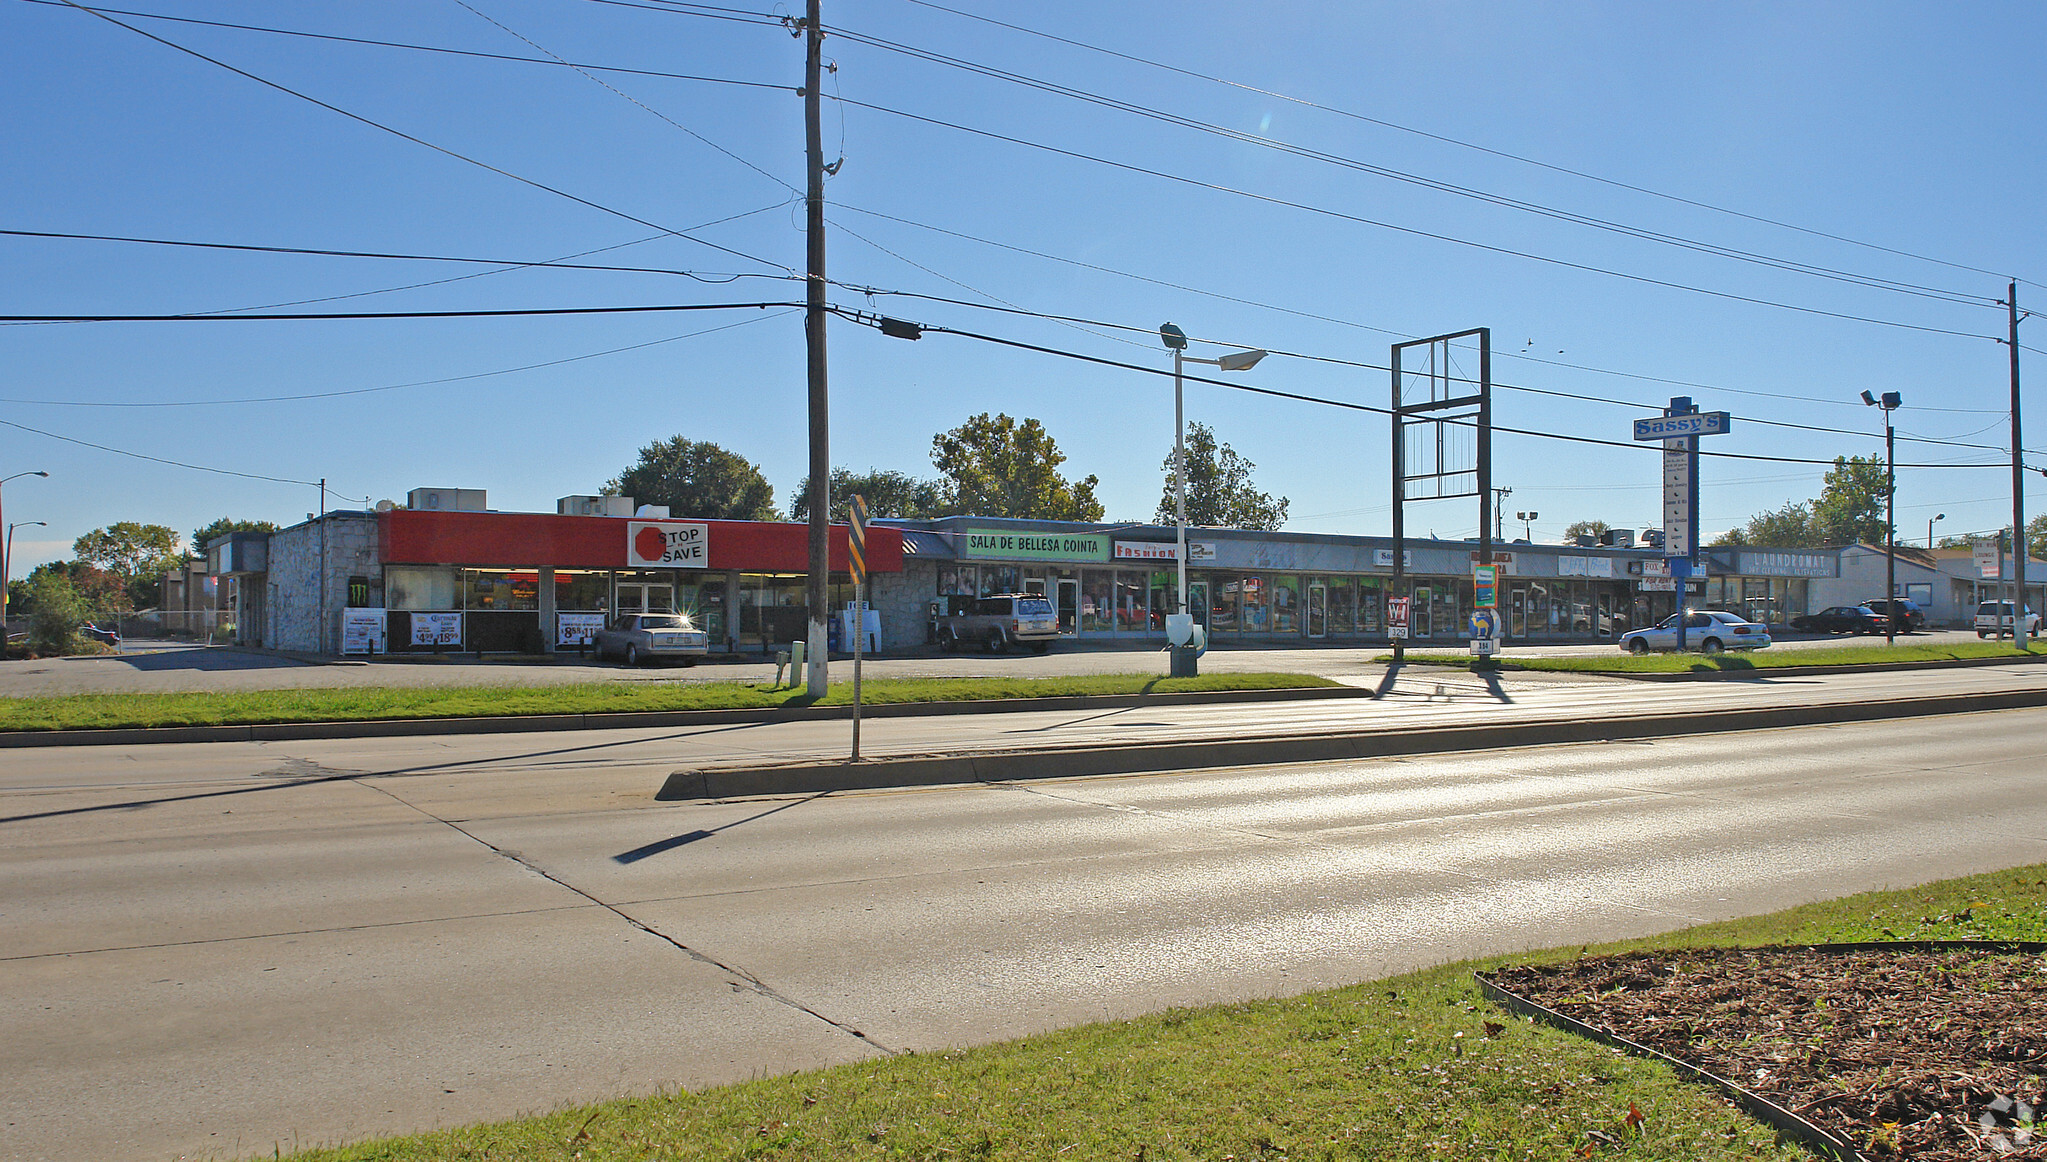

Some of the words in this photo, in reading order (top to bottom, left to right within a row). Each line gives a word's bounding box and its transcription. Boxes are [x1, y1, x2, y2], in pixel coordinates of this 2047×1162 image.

[1636, 416, 1718, 434] Sassy's
[658, 529, 699, 544] STOP
[970, 535, 997, 549] SALA
[1000, 536, 1013, 550] DE
[1018, 537, 1060, 551] BELLESA
[1063, 540, 1098, 553] COINTA
[663, 546, 702, 562] SAVE
[1117, 545, 1176, 558] FASHION
[1644, 562, 1658, 570] FOX
[1754, 552, 1825, 568] LAUNDROMAT
